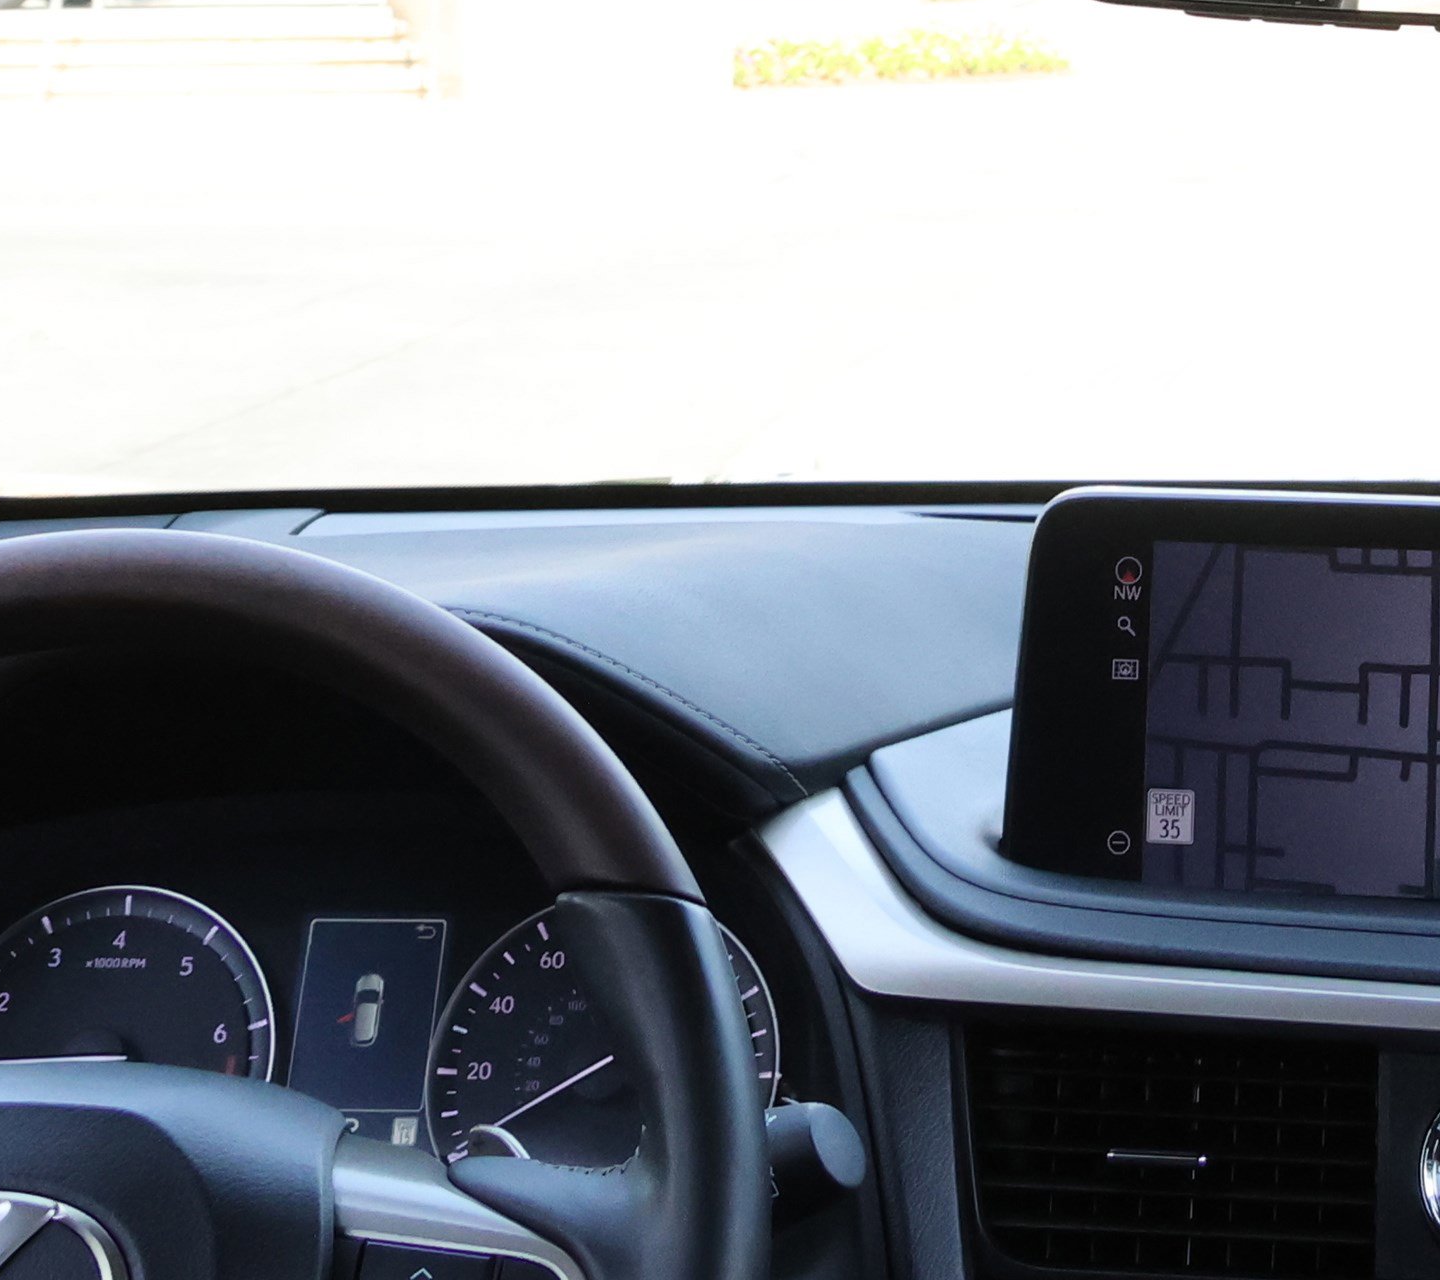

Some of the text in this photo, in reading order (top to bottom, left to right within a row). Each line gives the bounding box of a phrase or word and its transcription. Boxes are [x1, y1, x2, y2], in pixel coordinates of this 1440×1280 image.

[1114, 585, 1141, 600] NW
[1152, 793, 1190, 806] SPEED
[1155, 804, 1185, 816] LIMIT
[1159, 818, 1180, 839] 35
[112, 930, 127, 950] 4
[47, 948, 62, 968] 3
[179, 956, 194, 976] 5
[539, 951, 565, 969] 60
[489, 995, 514, 1014] 40
[213, 1023, 228, 1043] 6
[526, 1056, 541, 1067] 40
[467, 1062, 492, 1080] 20
